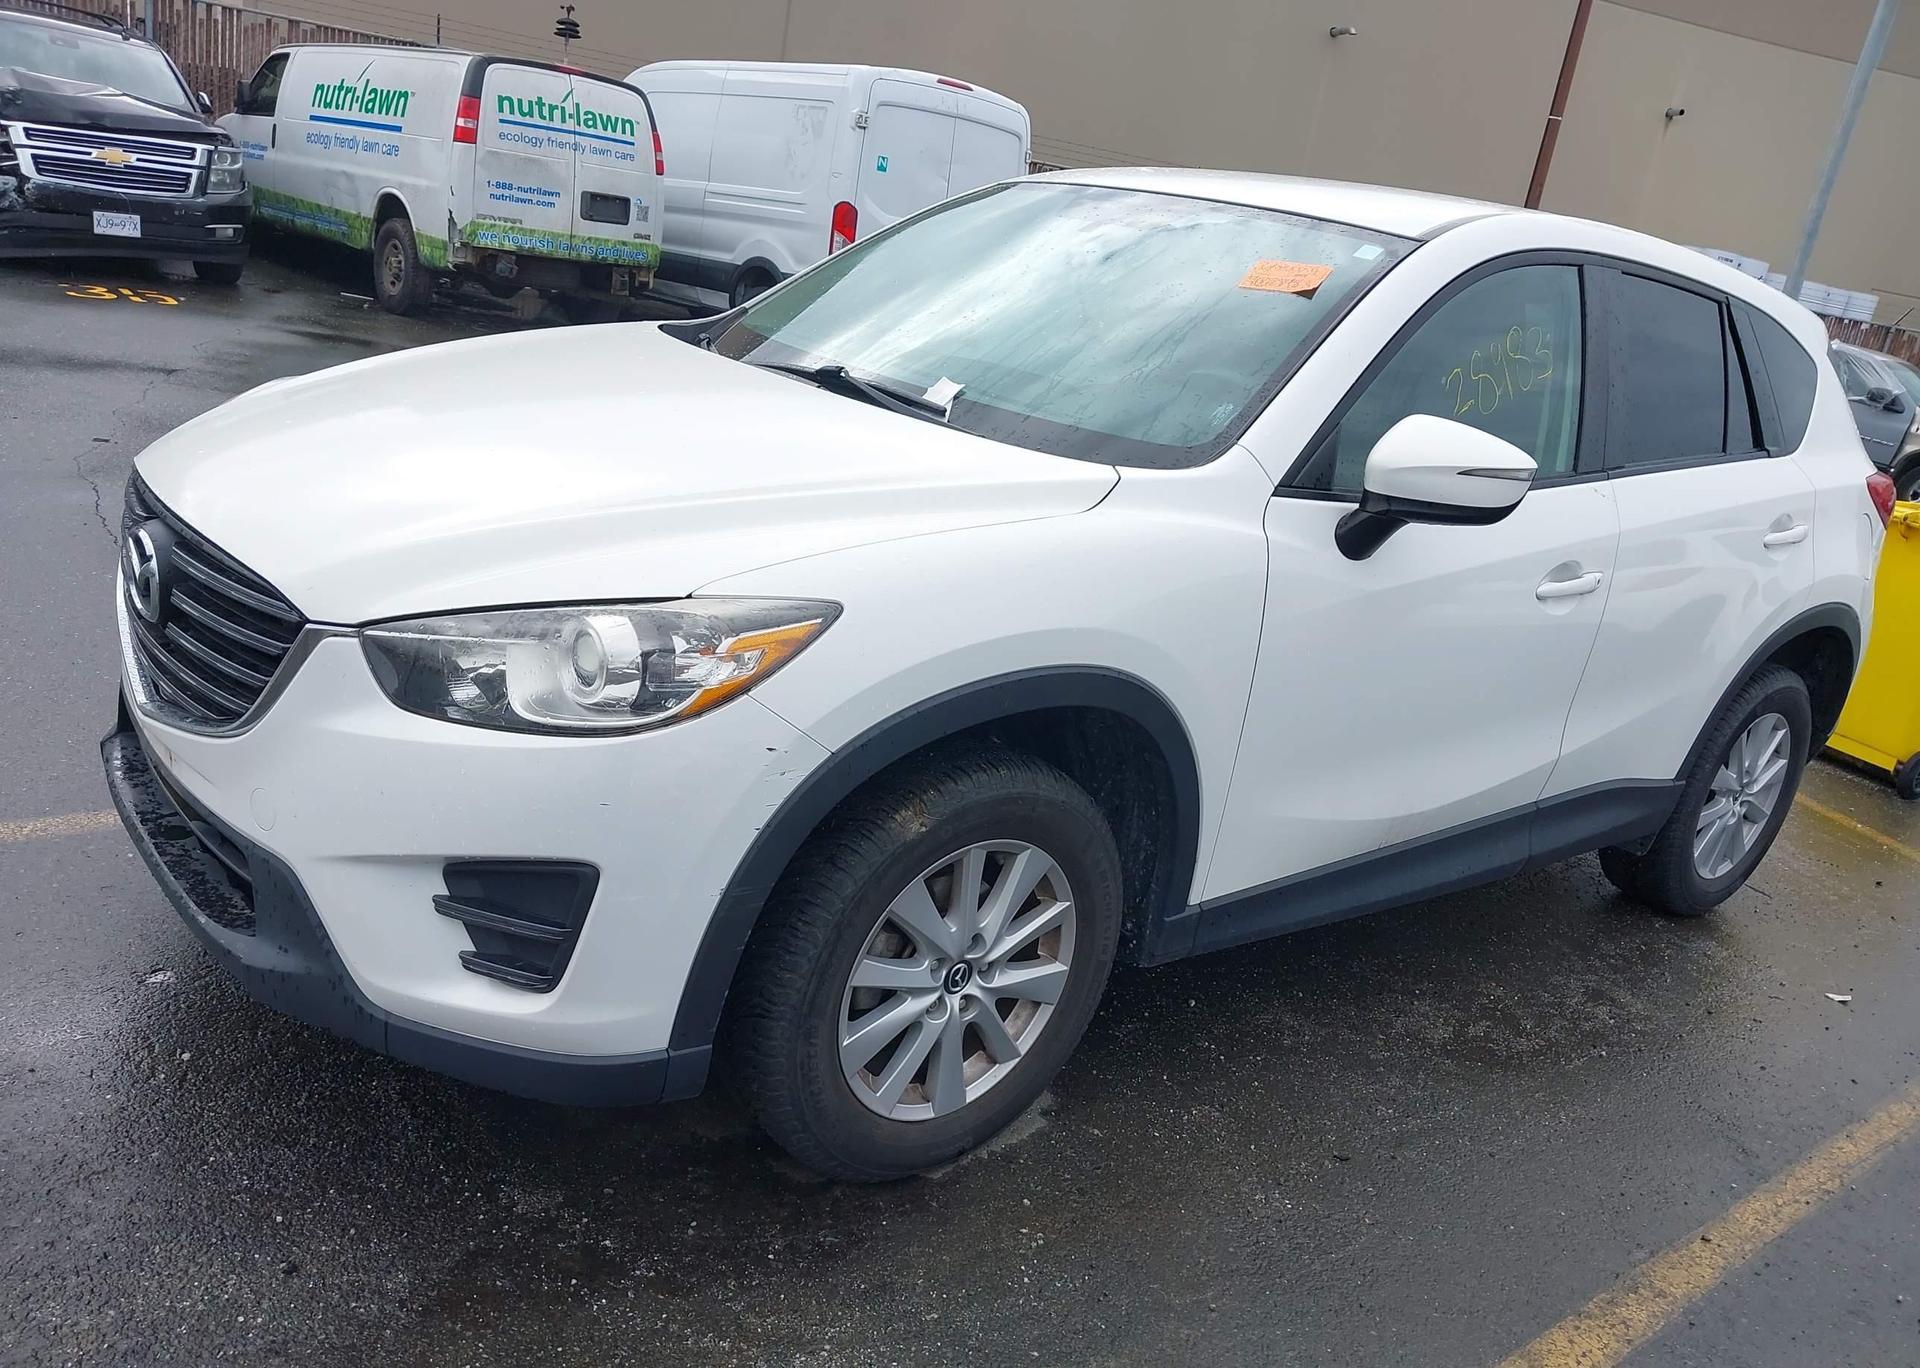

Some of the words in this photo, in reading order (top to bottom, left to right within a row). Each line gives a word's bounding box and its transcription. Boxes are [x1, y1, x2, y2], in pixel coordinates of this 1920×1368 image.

[306, 131, 332, 150] ecology
[334, 132, 360, 154] friendly
[362, 137, 380, 154] lawn
[382, 143, 400, 157] care
[499, 131, 544, 148] ecology
[547, 137, 587, 155] friendly
[589, 144, 612, 157] lawn
[615, 151, 635, 162] care
[486, 180, 561, 198] 1-888-nutrilawn
[489, 193, 556, 208] nutrilawn.com
[479, 231, 498, 242] we
[502, 232, 554, 250] nourish
[559, 240, 594, 255] lawns
[597, 246, 619, 257] and
[623, 247, 647, 260] lives
